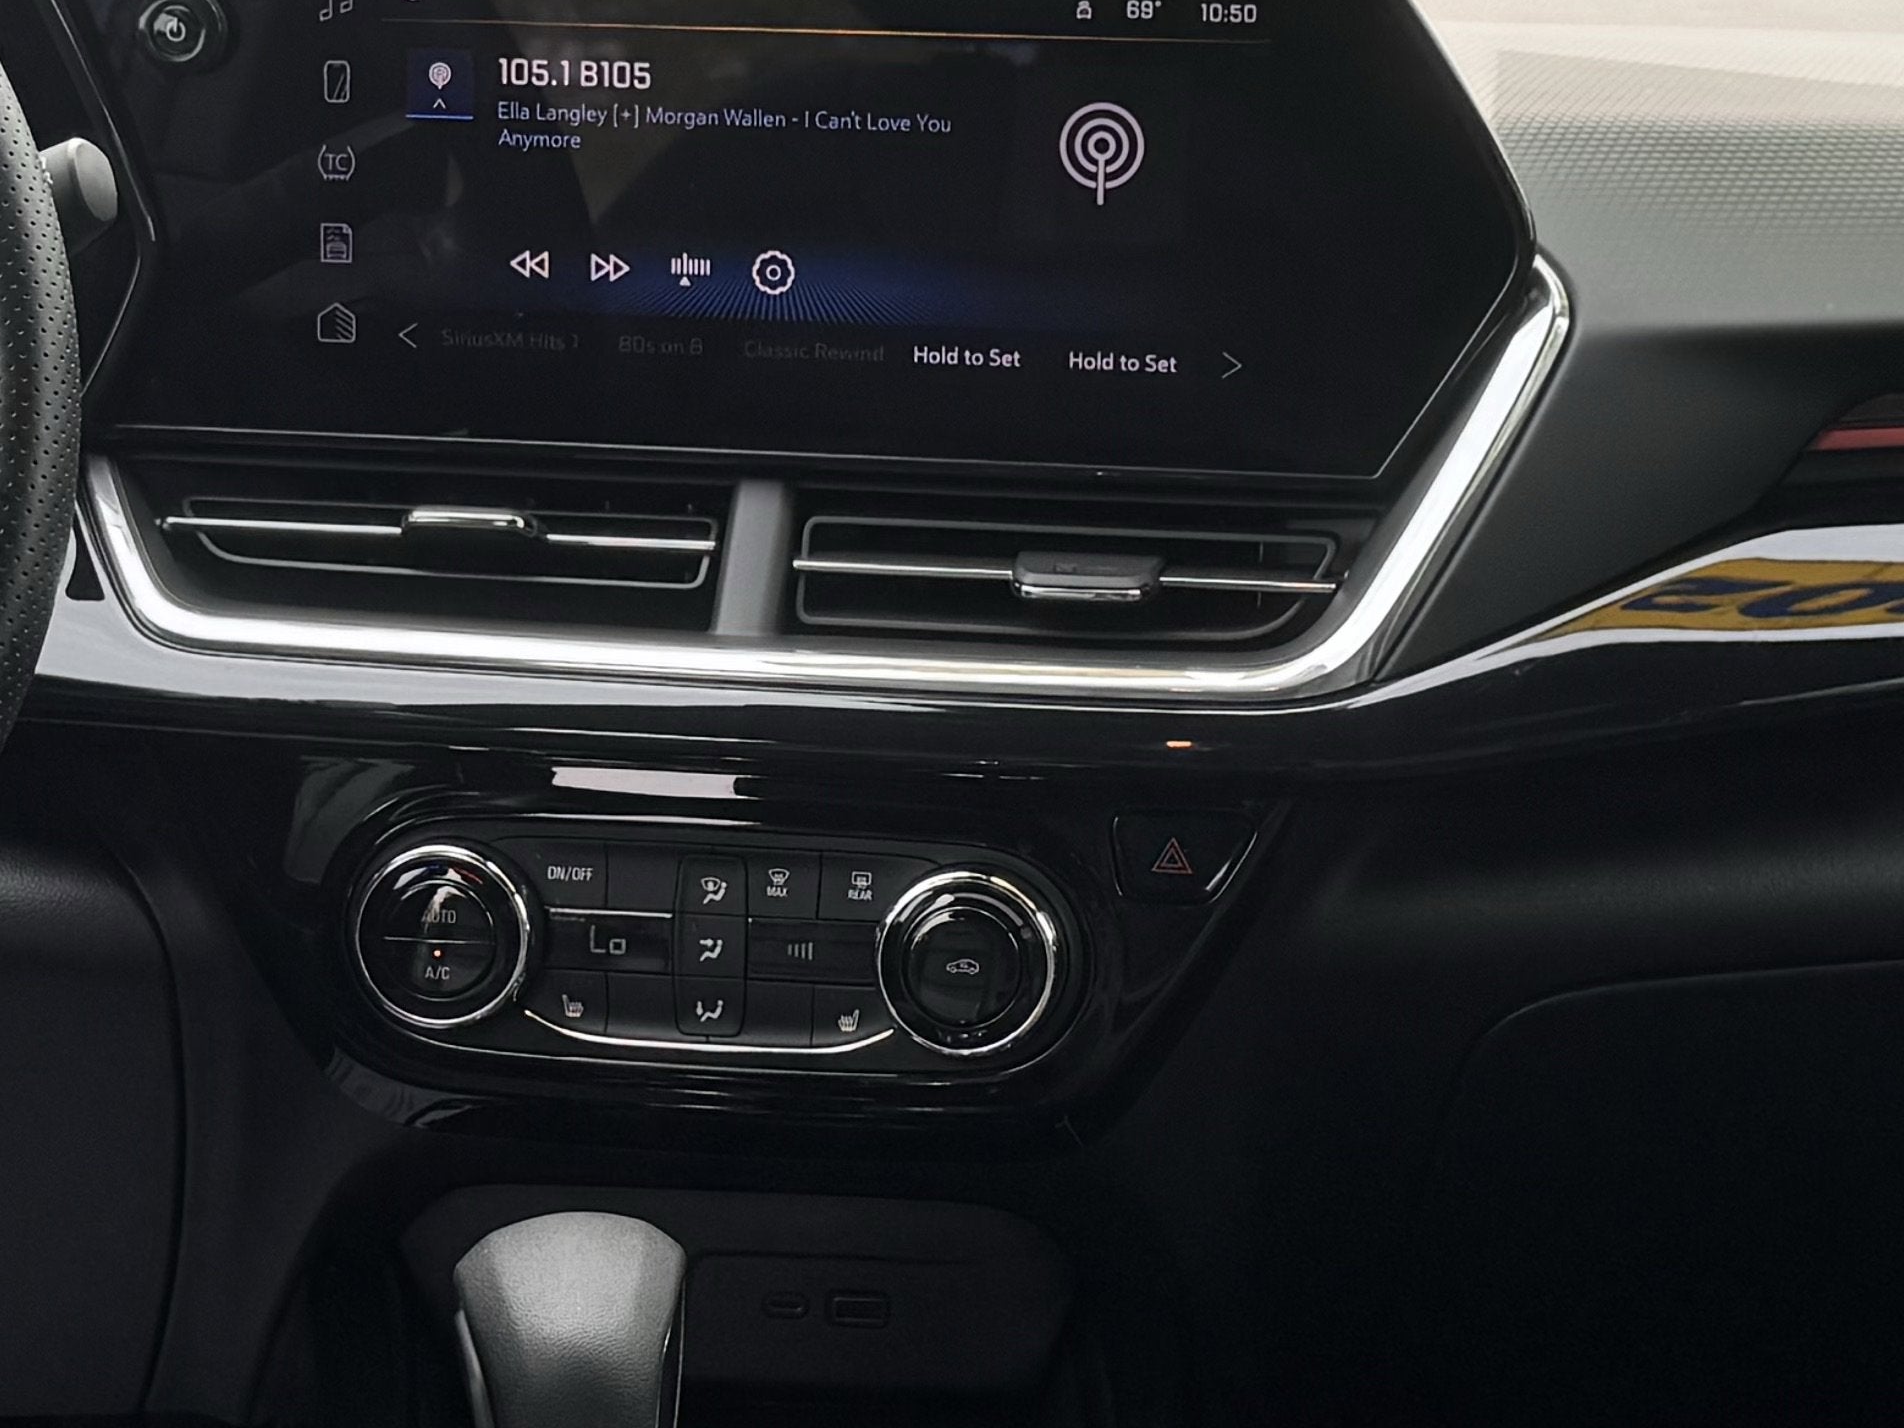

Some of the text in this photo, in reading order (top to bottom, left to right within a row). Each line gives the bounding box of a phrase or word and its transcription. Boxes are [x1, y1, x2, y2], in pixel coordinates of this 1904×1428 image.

[1201, 2, 1257, 23] 10:50
[498, 57, 651, 90] 105.1 B105
[497, 100, 531, 120] Ella
[536, 102, 608, 127] Langley
[645, 105, 719, 130] Morgan
[722, 107, 786, 128] Wallen
[814, 109, 861, 130] Can't
[866, 112, 911, 132] Love
[915, 113, 952, 133] You
[498, 128, 582, 152] Anymore
[744, 339, 885, 362] Classic Rewind
[913, 345, 1021, 369] Hold to Set
[1068, 351, 1178, 375] Hold to Set
[546, 866, 594, 882] ON/OFF
[766, 885, 789, 898] MAX
[847, 888, 873, 901] REAR
[423, 910, 457, 924] AUTO
[425, 966, 451, 980] A/C
